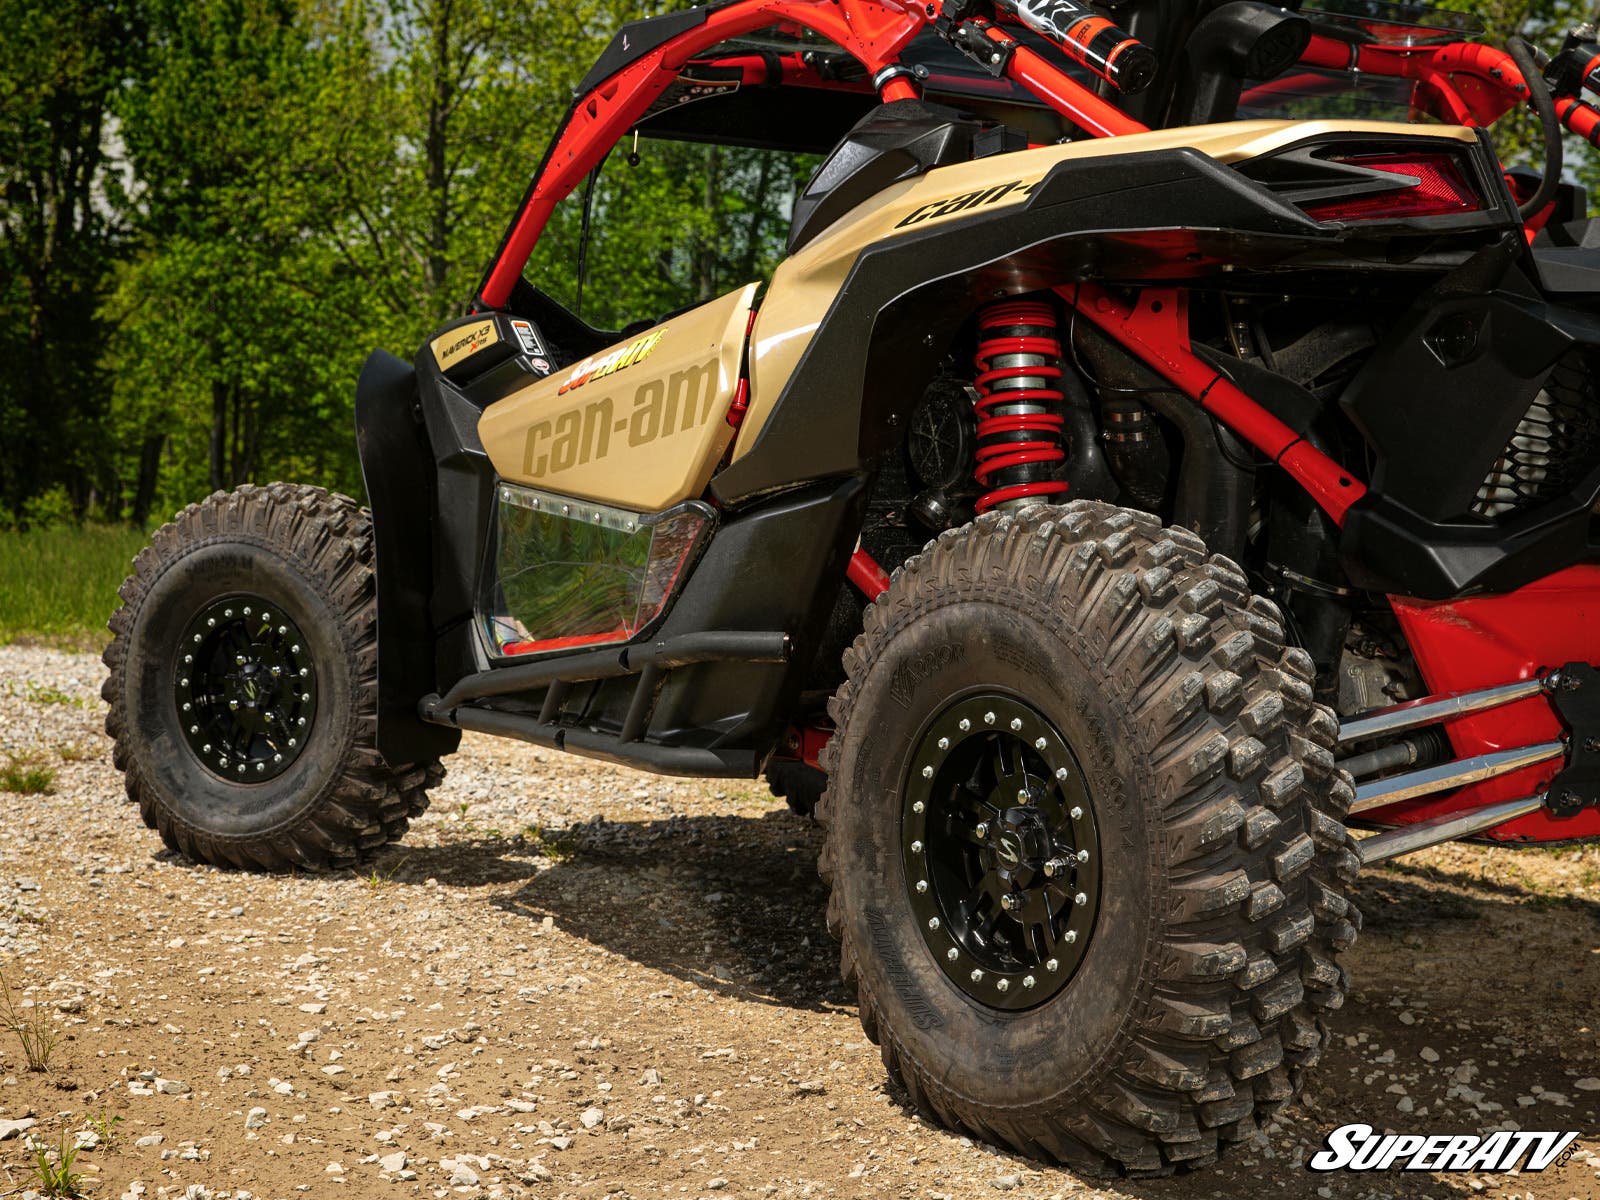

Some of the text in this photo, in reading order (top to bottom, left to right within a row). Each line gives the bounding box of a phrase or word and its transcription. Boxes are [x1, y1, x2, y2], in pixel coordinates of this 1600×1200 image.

[442, 324, 491, 360] MAVERICK X3
[522, 357, 721, 479] can-am
[890, 642, 969, 709] WARRIOR
